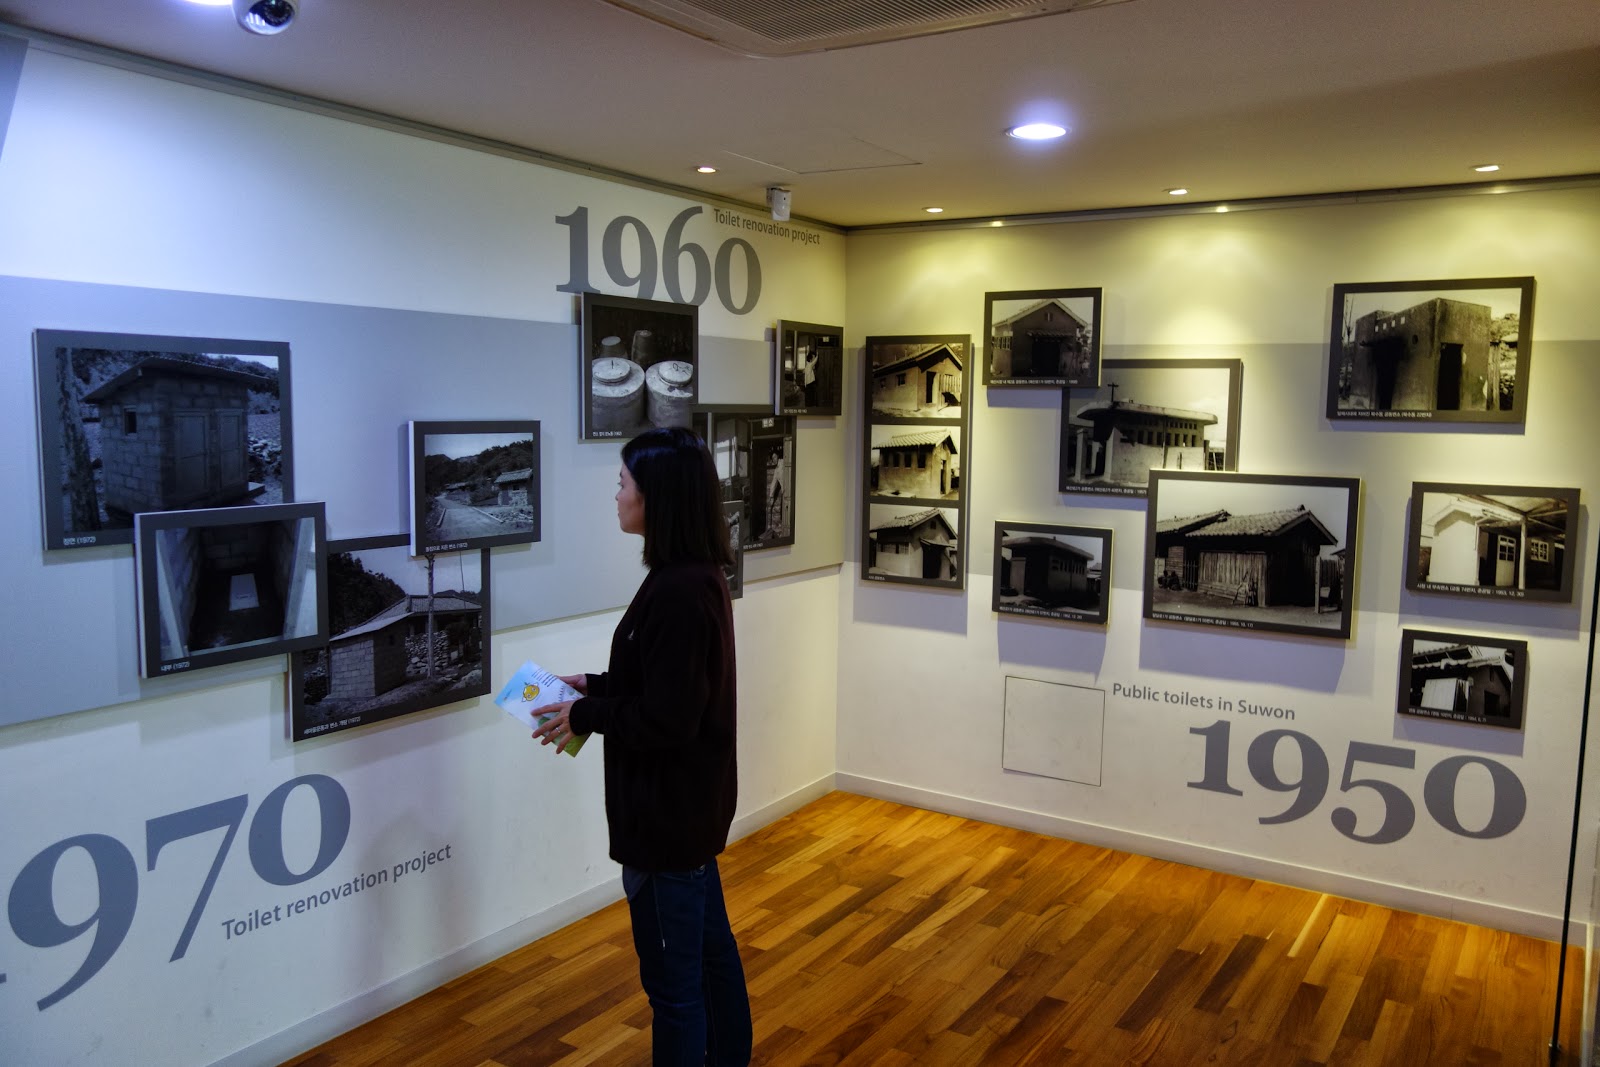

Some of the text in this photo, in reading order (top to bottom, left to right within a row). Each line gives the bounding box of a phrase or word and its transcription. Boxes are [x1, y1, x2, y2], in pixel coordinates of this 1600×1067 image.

[555, 206, 762, 315] 1960
[714, 208, 820, 245] Toilet renovation project
[1112, 682, 1296, 721] Public toilets in Suwon
[1187, 719, 1527, 845] 1950
[0, 774, 351, 1012] 970
[222, 843, 452, 941] Toilet renovation project
